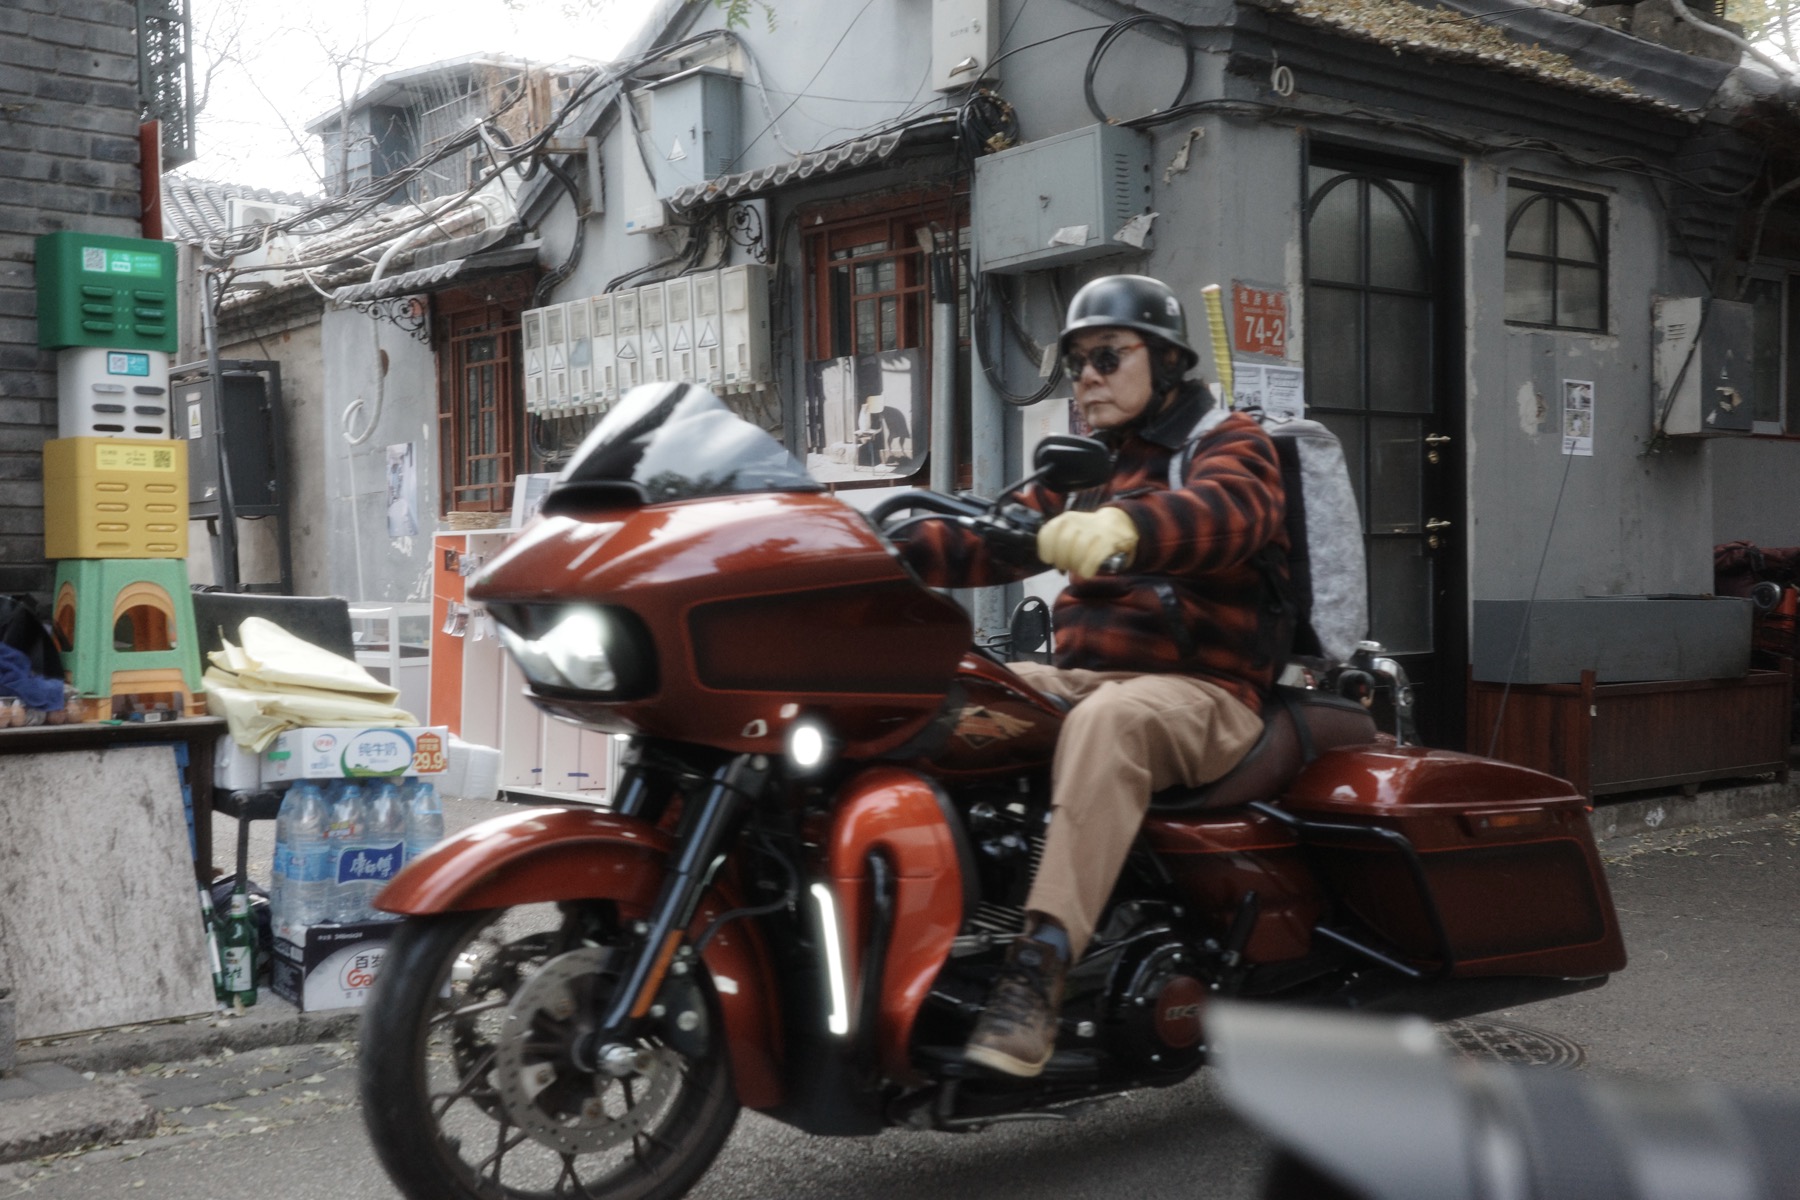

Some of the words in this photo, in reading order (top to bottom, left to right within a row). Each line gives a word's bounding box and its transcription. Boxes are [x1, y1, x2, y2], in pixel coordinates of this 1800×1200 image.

[1245, 316, 1283, 345] 74-2
[358, 742, 398, 757] 纯牛奶
[412, 752, 443, 770] 29.9
[350, 852, 393, 877] 康师傅
